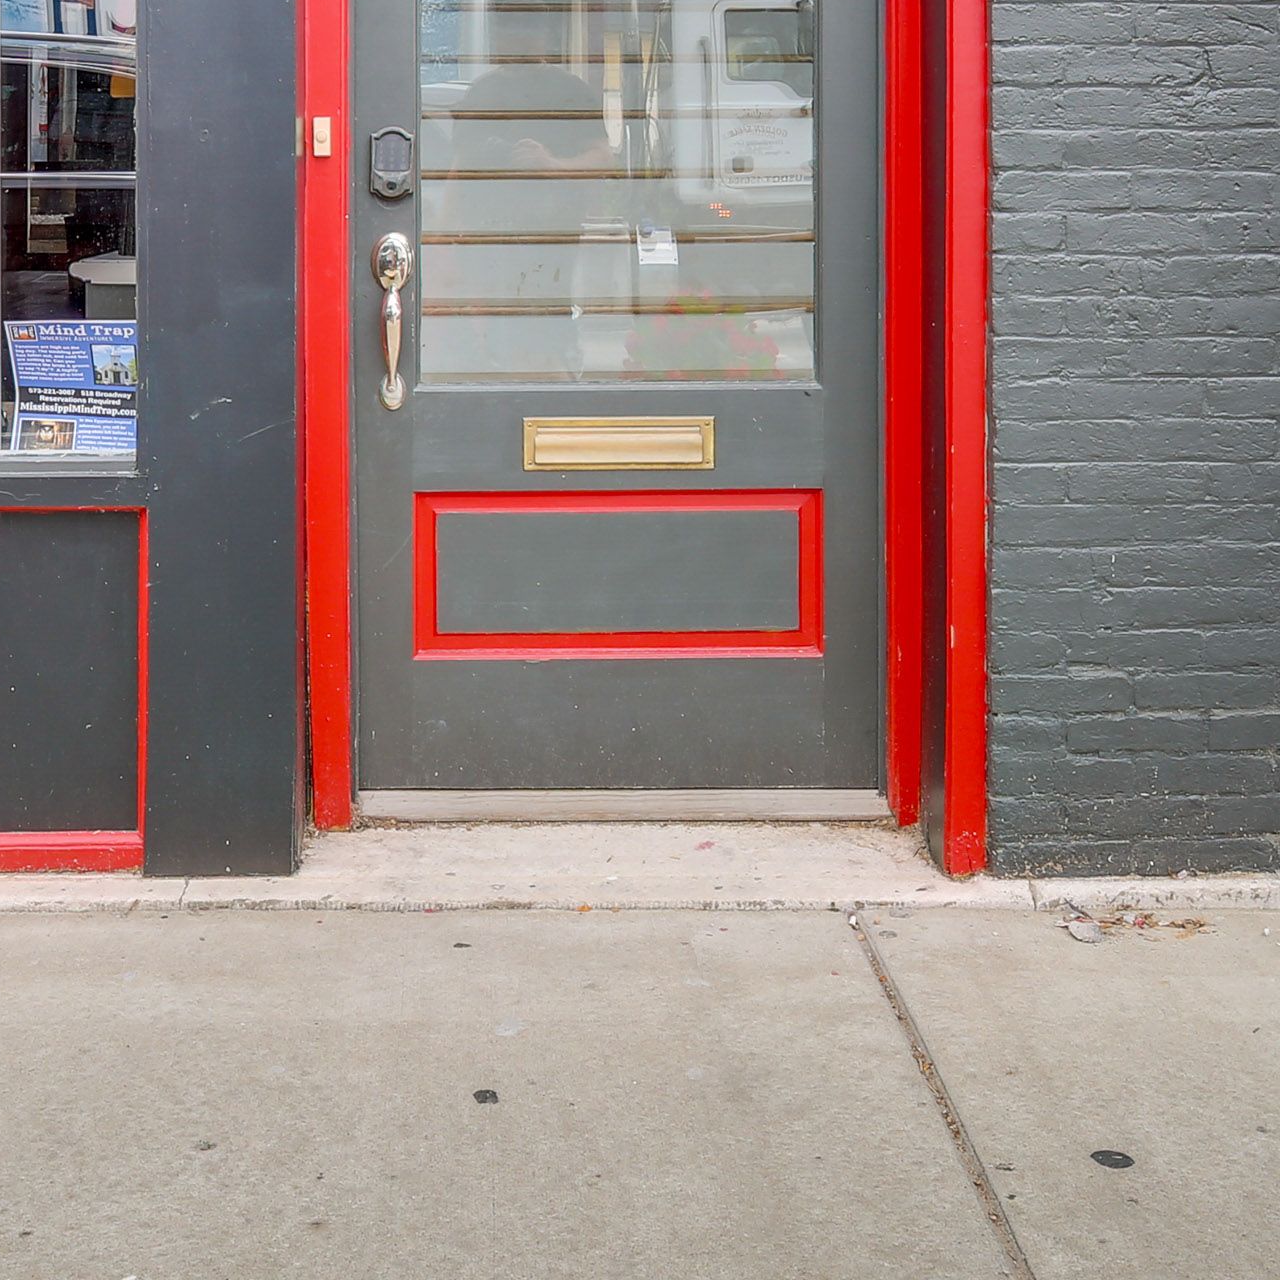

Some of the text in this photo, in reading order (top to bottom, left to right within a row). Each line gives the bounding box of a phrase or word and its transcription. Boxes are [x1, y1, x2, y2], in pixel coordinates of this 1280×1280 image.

[38, 325, 134, 339] Mind Trap
[39, 395, 121, 406] Reservations Required
[95, 391, 132, 400] Broadway
